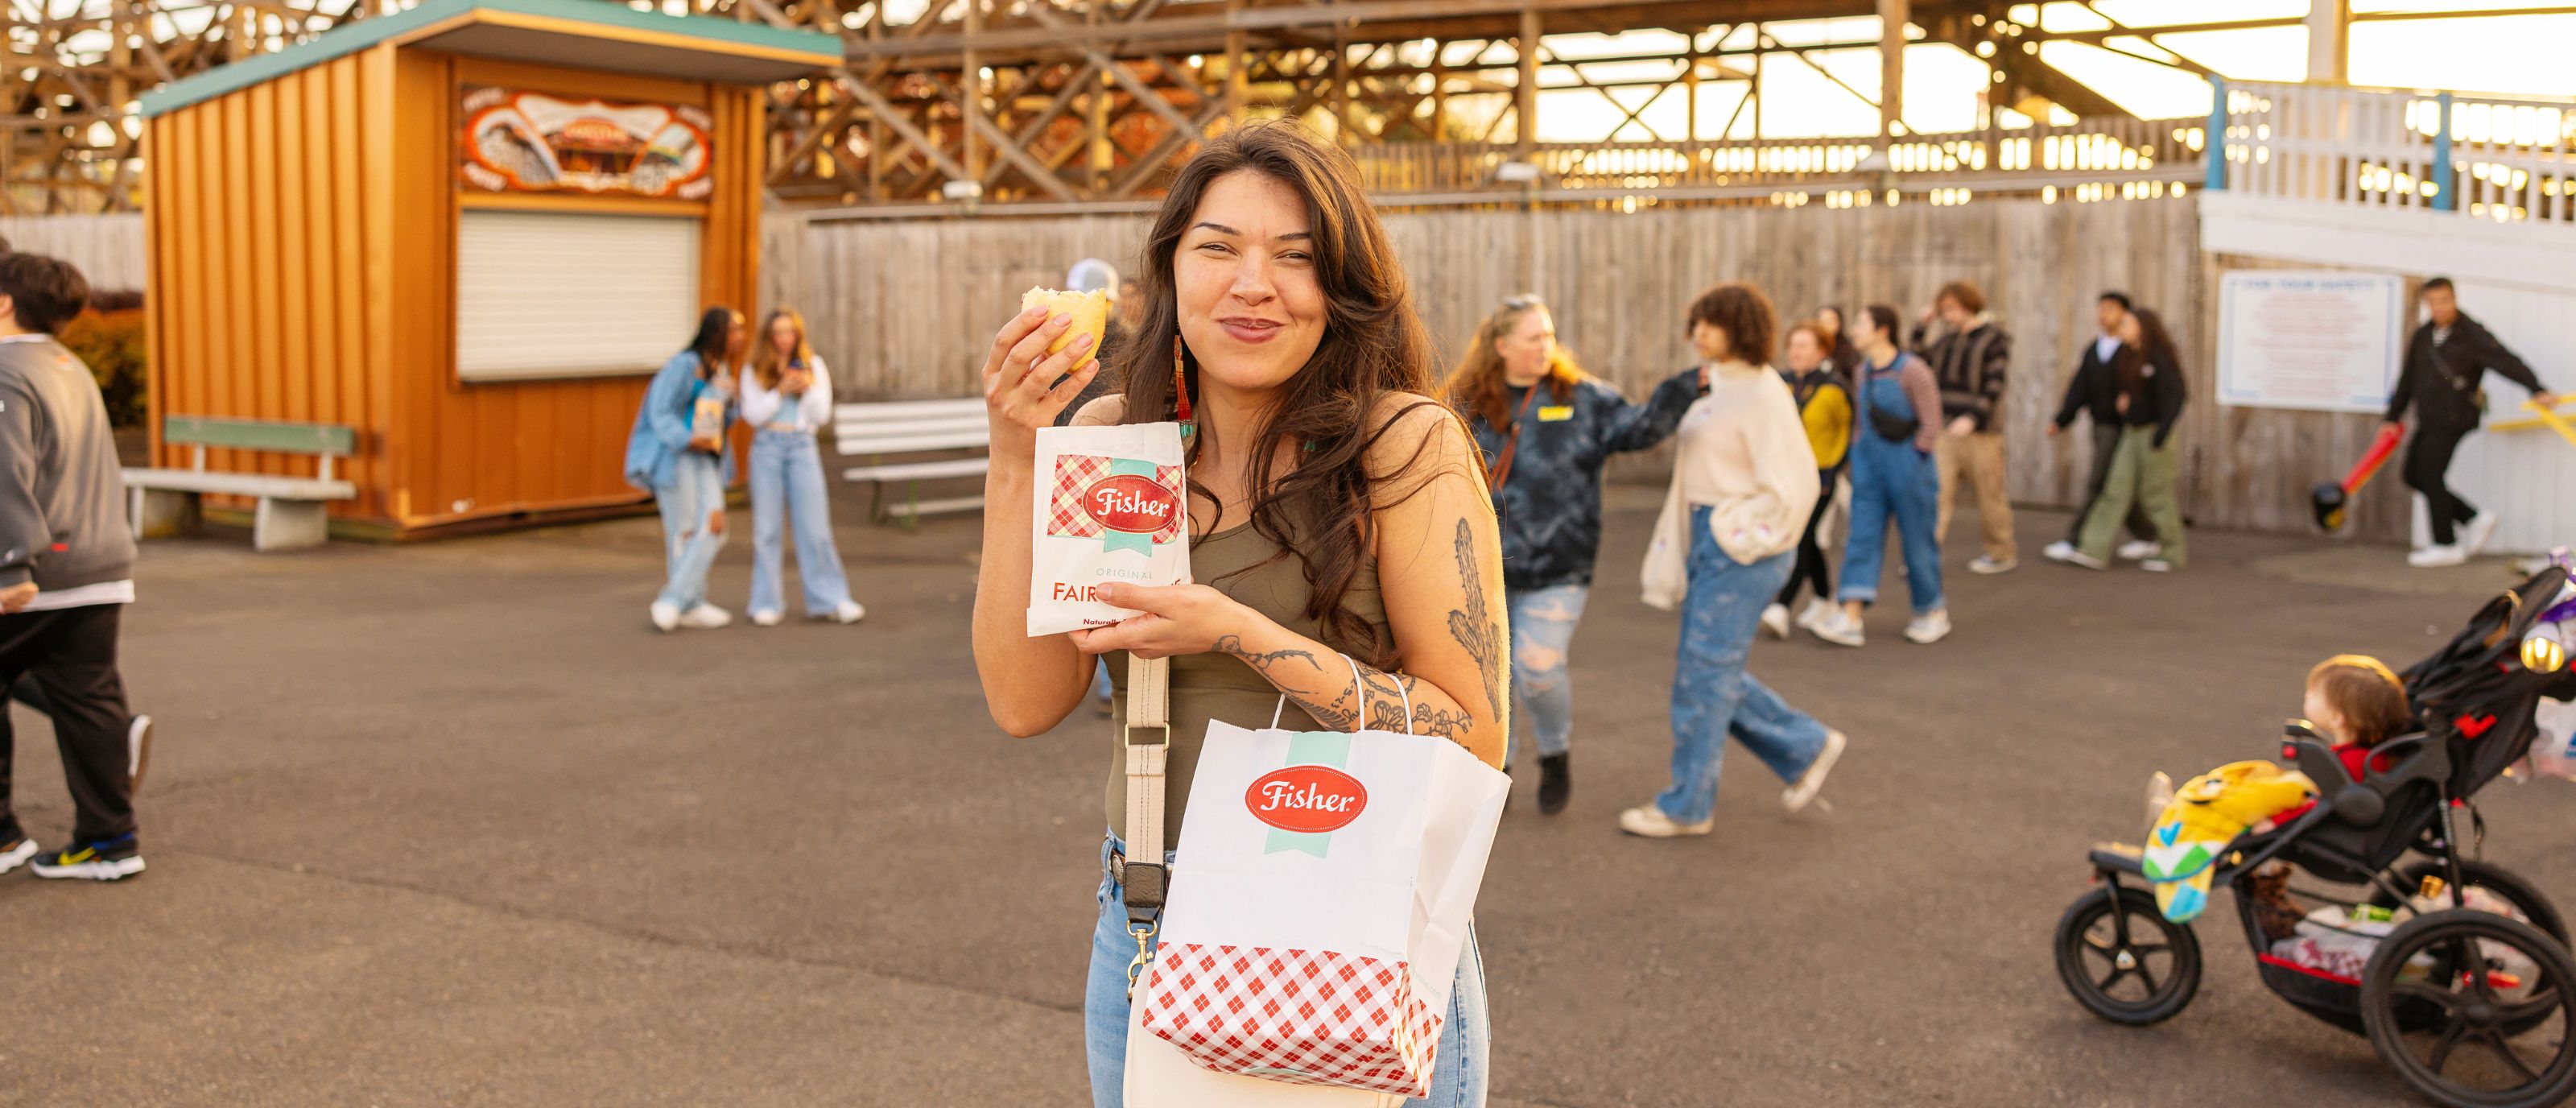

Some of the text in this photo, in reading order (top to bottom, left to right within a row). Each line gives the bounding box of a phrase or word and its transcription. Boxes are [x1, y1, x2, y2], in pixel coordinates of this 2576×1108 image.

[1096, 487, 1170, 517] Fisher
[1096, 568, 1154, 580] ORIGINAL
[1053, 582, 1098, 602] FAIR
[1260, 780, 1356, 812] Fisher
